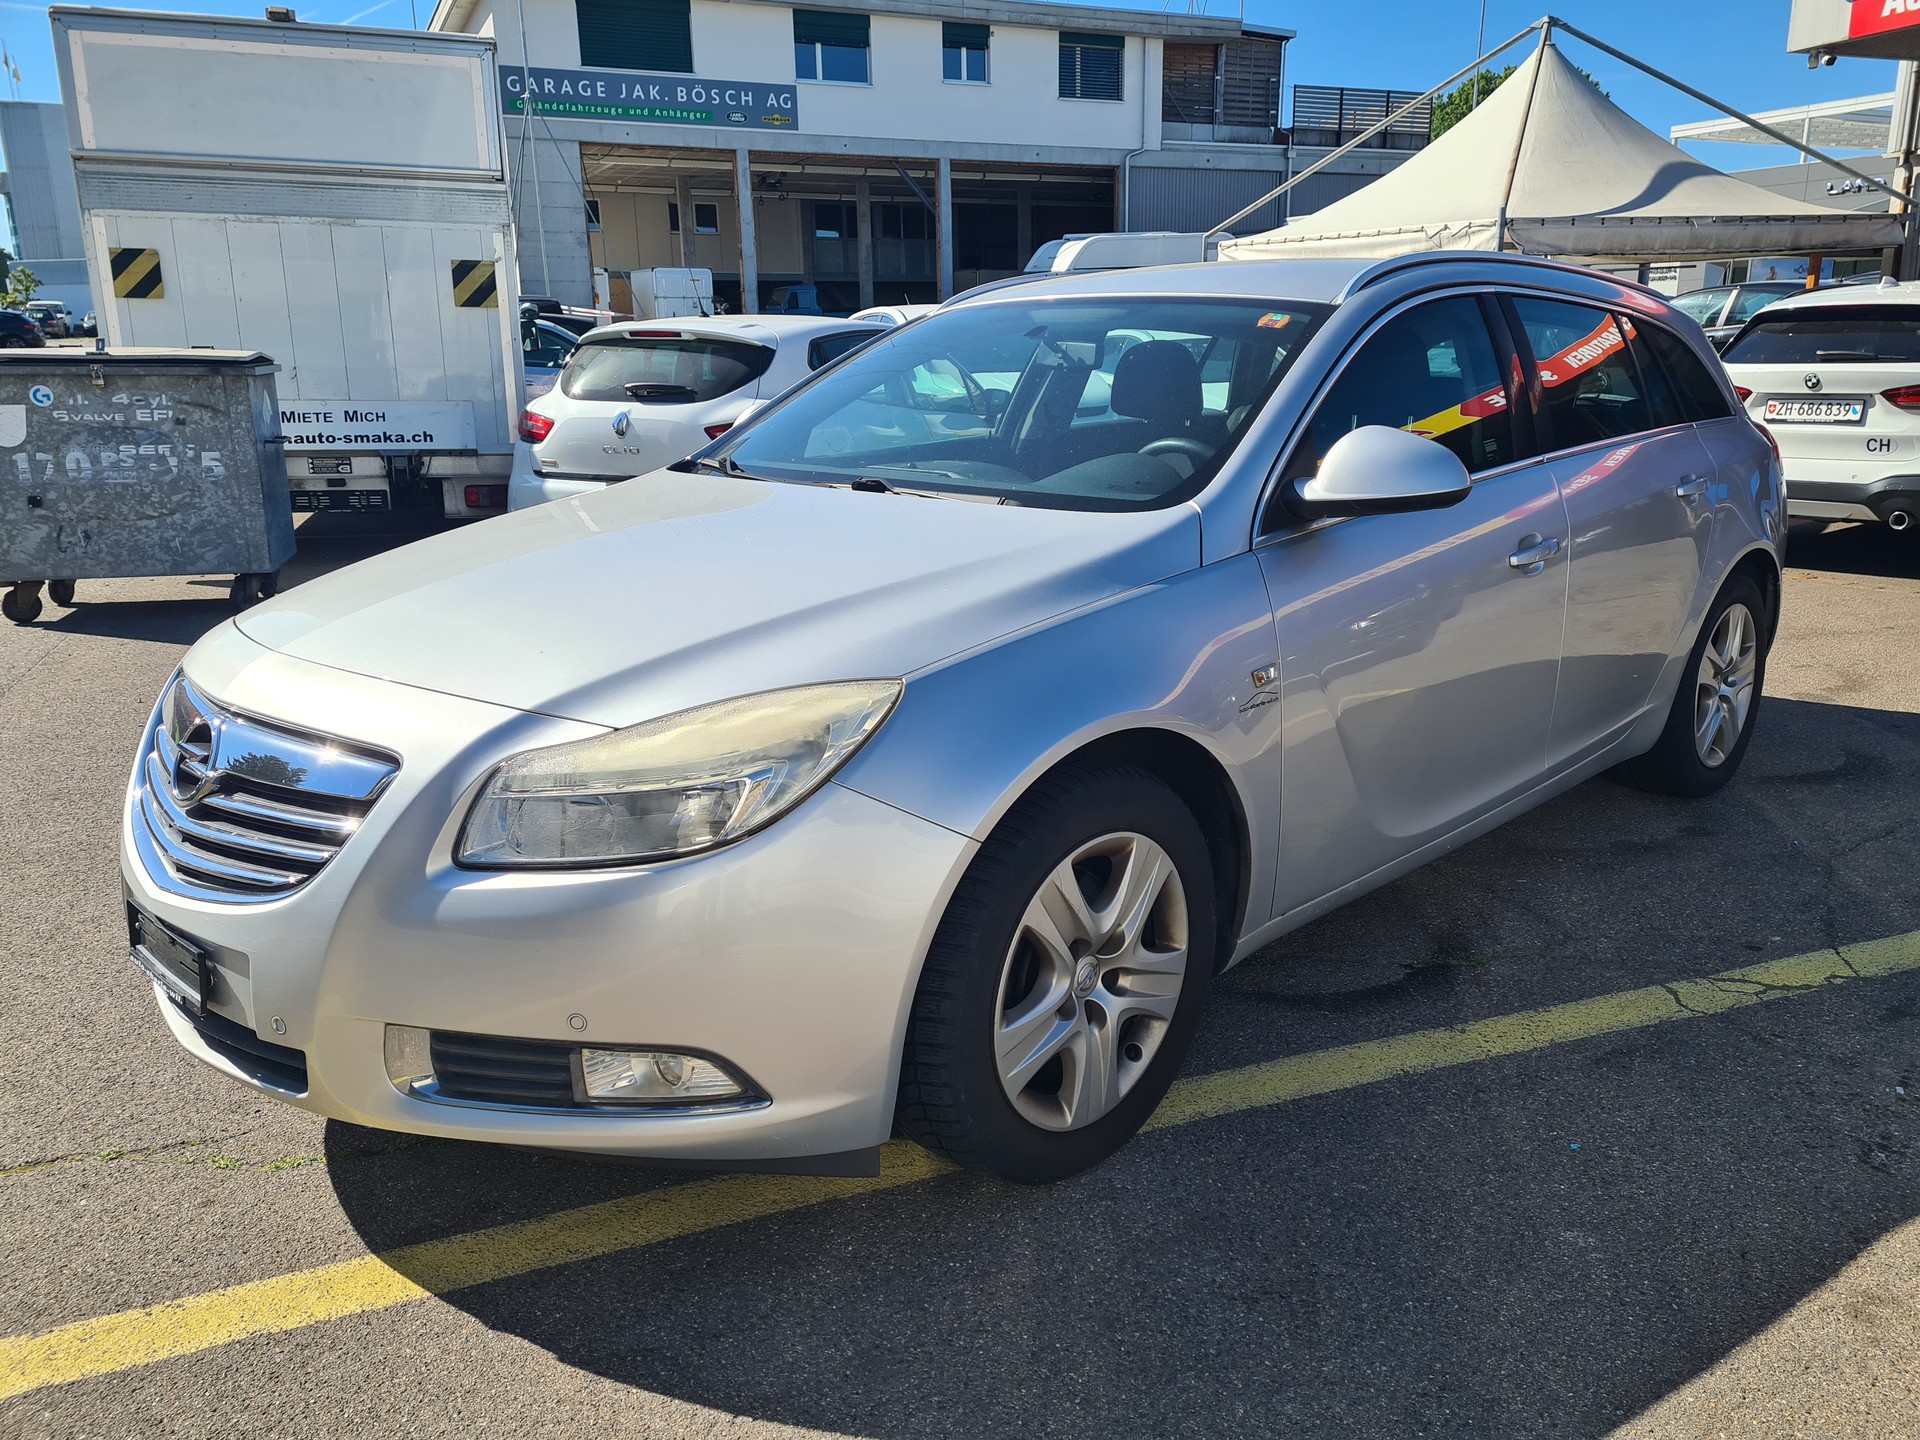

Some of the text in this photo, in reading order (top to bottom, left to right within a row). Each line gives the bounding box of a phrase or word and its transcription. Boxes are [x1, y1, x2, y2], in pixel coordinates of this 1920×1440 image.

[506, 75, 792, 108] GARAGE JAK. BÖSCH AG
[516, 100, 707, 120] Gländefahrzeuge und Anhänger
[344, 410, 386, 423] MICH
[602, 445, 640, 455] CLIO
[1866, 438, 1891, 452] CH
